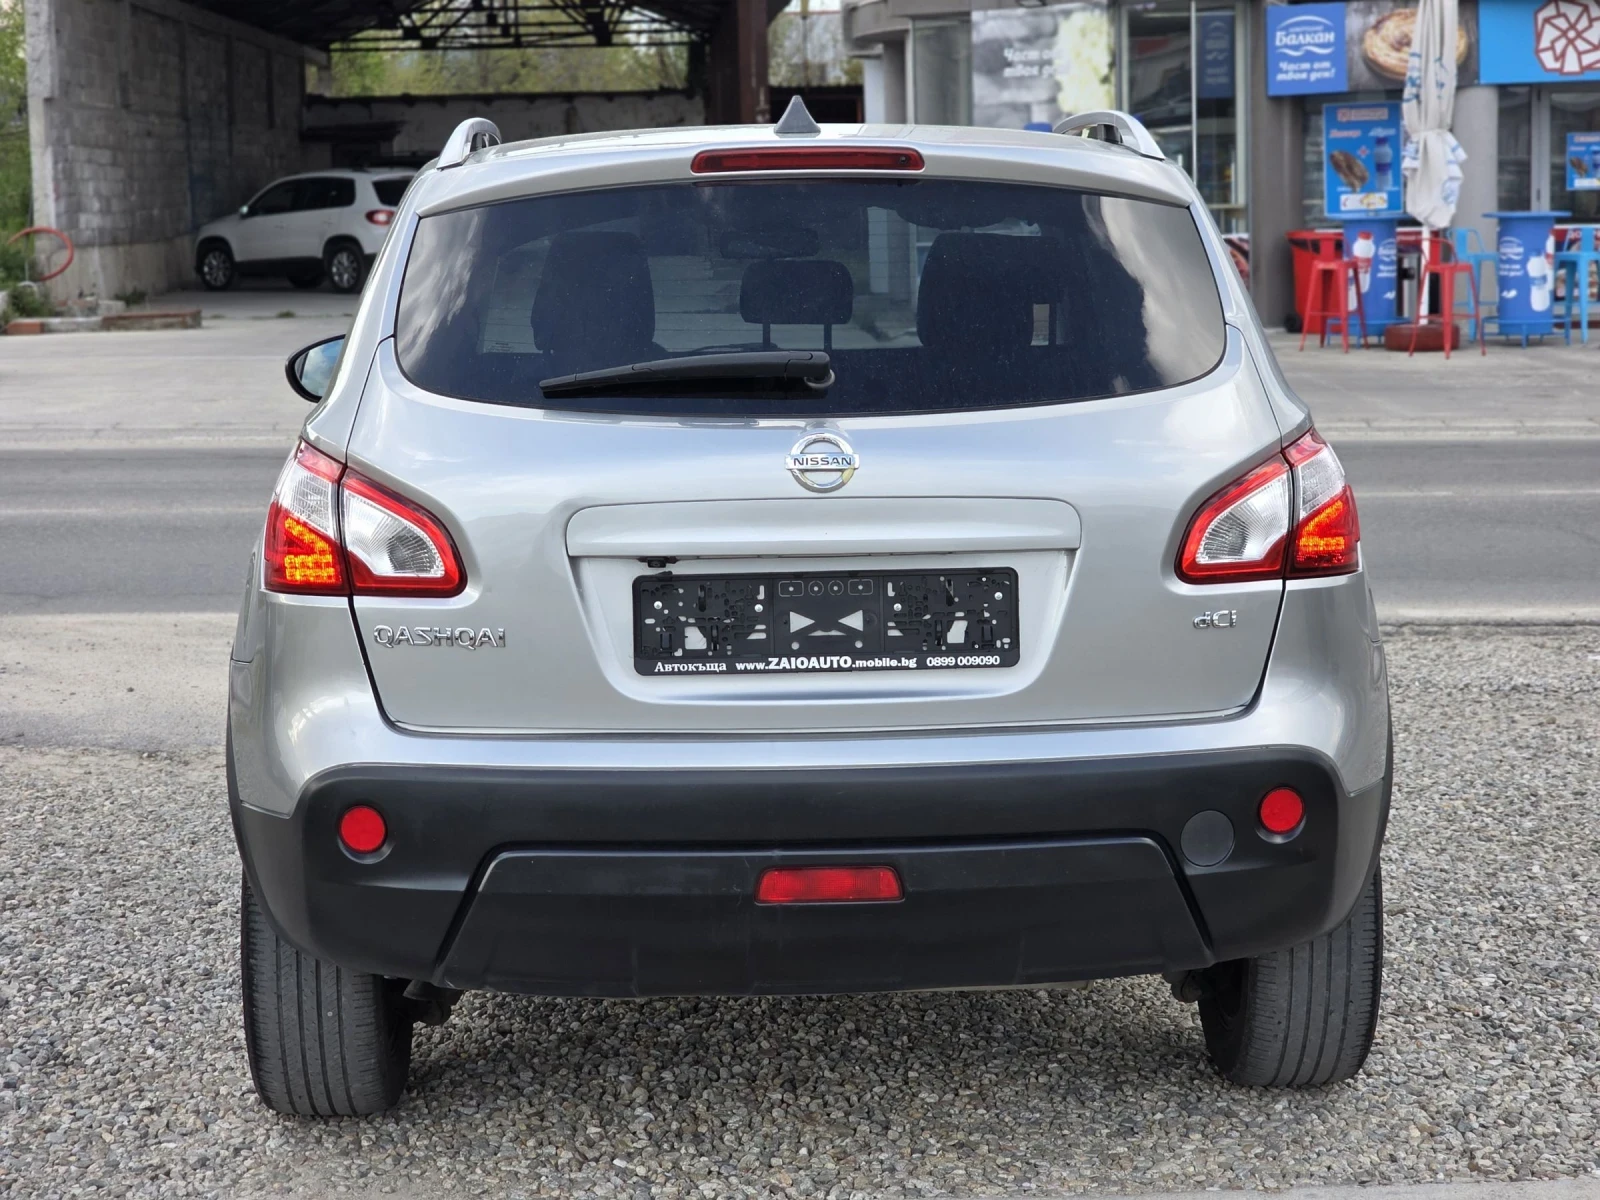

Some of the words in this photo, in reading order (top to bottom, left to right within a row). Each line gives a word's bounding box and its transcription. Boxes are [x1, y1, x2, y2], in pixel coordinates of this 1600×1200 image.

[1275, 31, 1335, 46] Балкан
[793, 457, 852, 466] NISSAN
[1193, 609, 1237, 628] dCi
[654, 661, 727, 672] Автокъща
[735, 655, 917, 671] www.ZAIOAUTO.mobile.bg
[926, 656, 956, 667] 0899
[957, 655, 1000, 666] 009090
